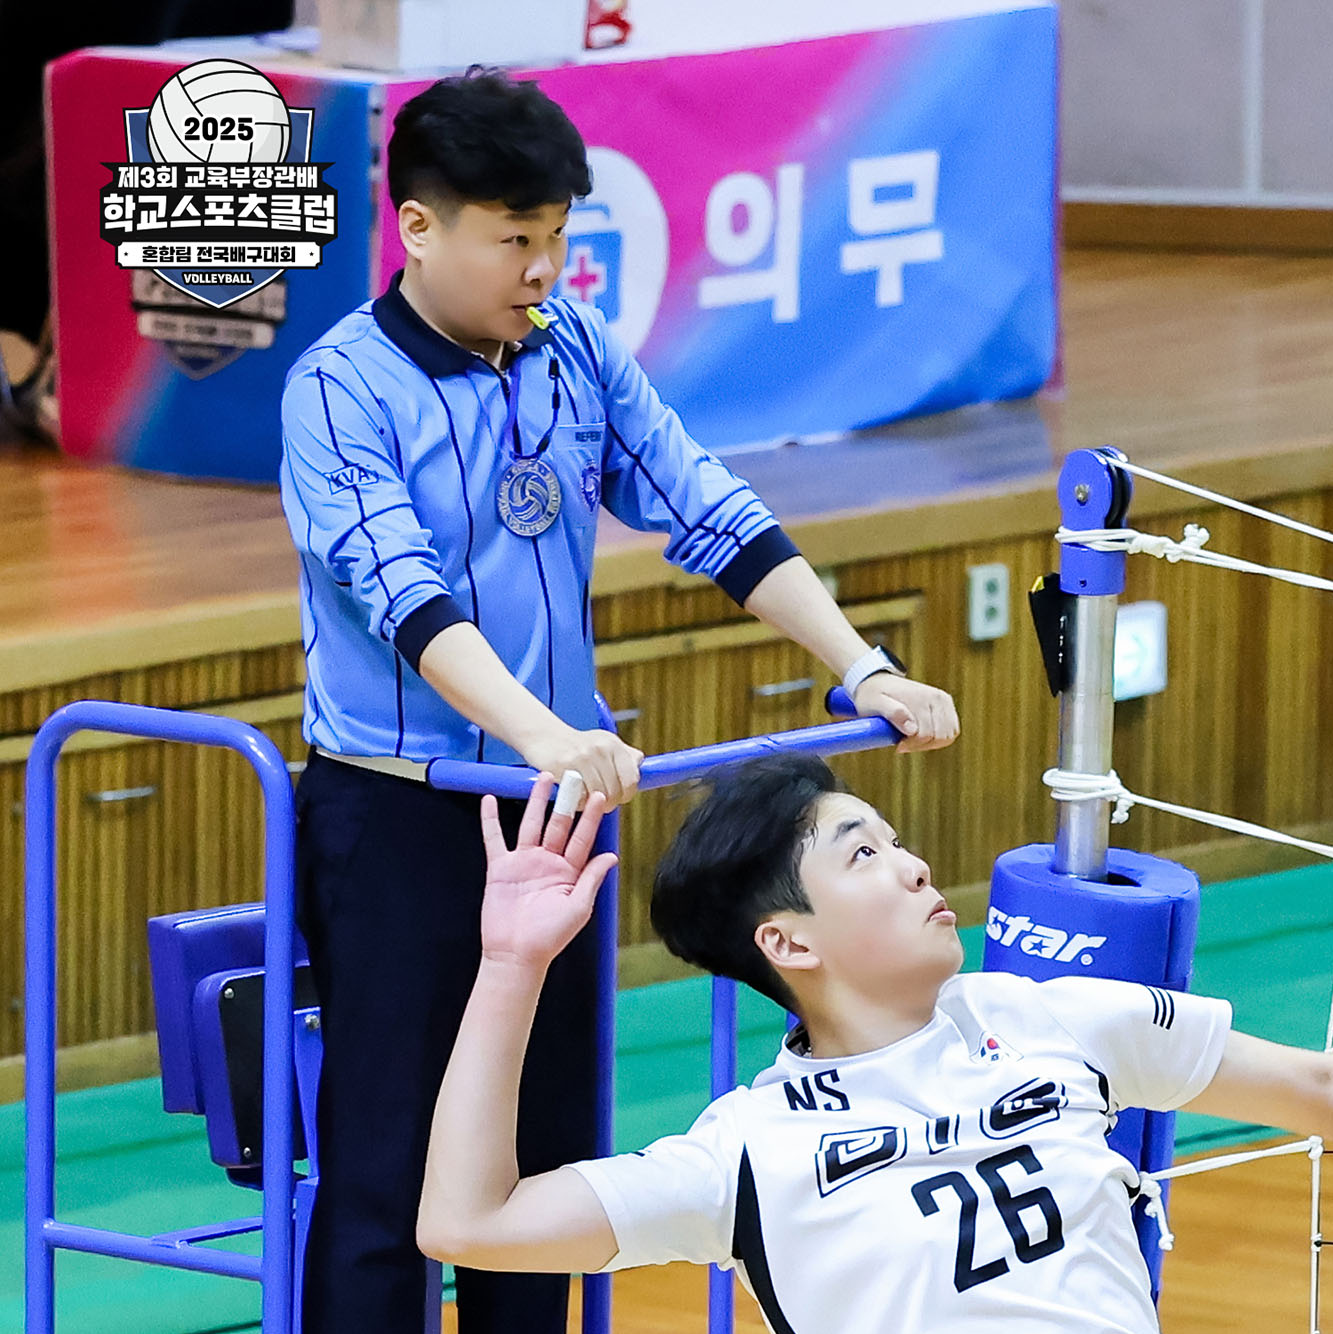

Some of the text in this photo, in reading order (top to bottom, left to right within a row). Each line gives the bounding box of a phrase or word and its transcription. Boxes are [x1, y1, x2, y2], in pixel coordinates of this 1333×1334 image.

[330, 467, 370, 488] KVA
[783, 1069, 850, 1112] NS
[911, 1144, 1065, 1293] 26
